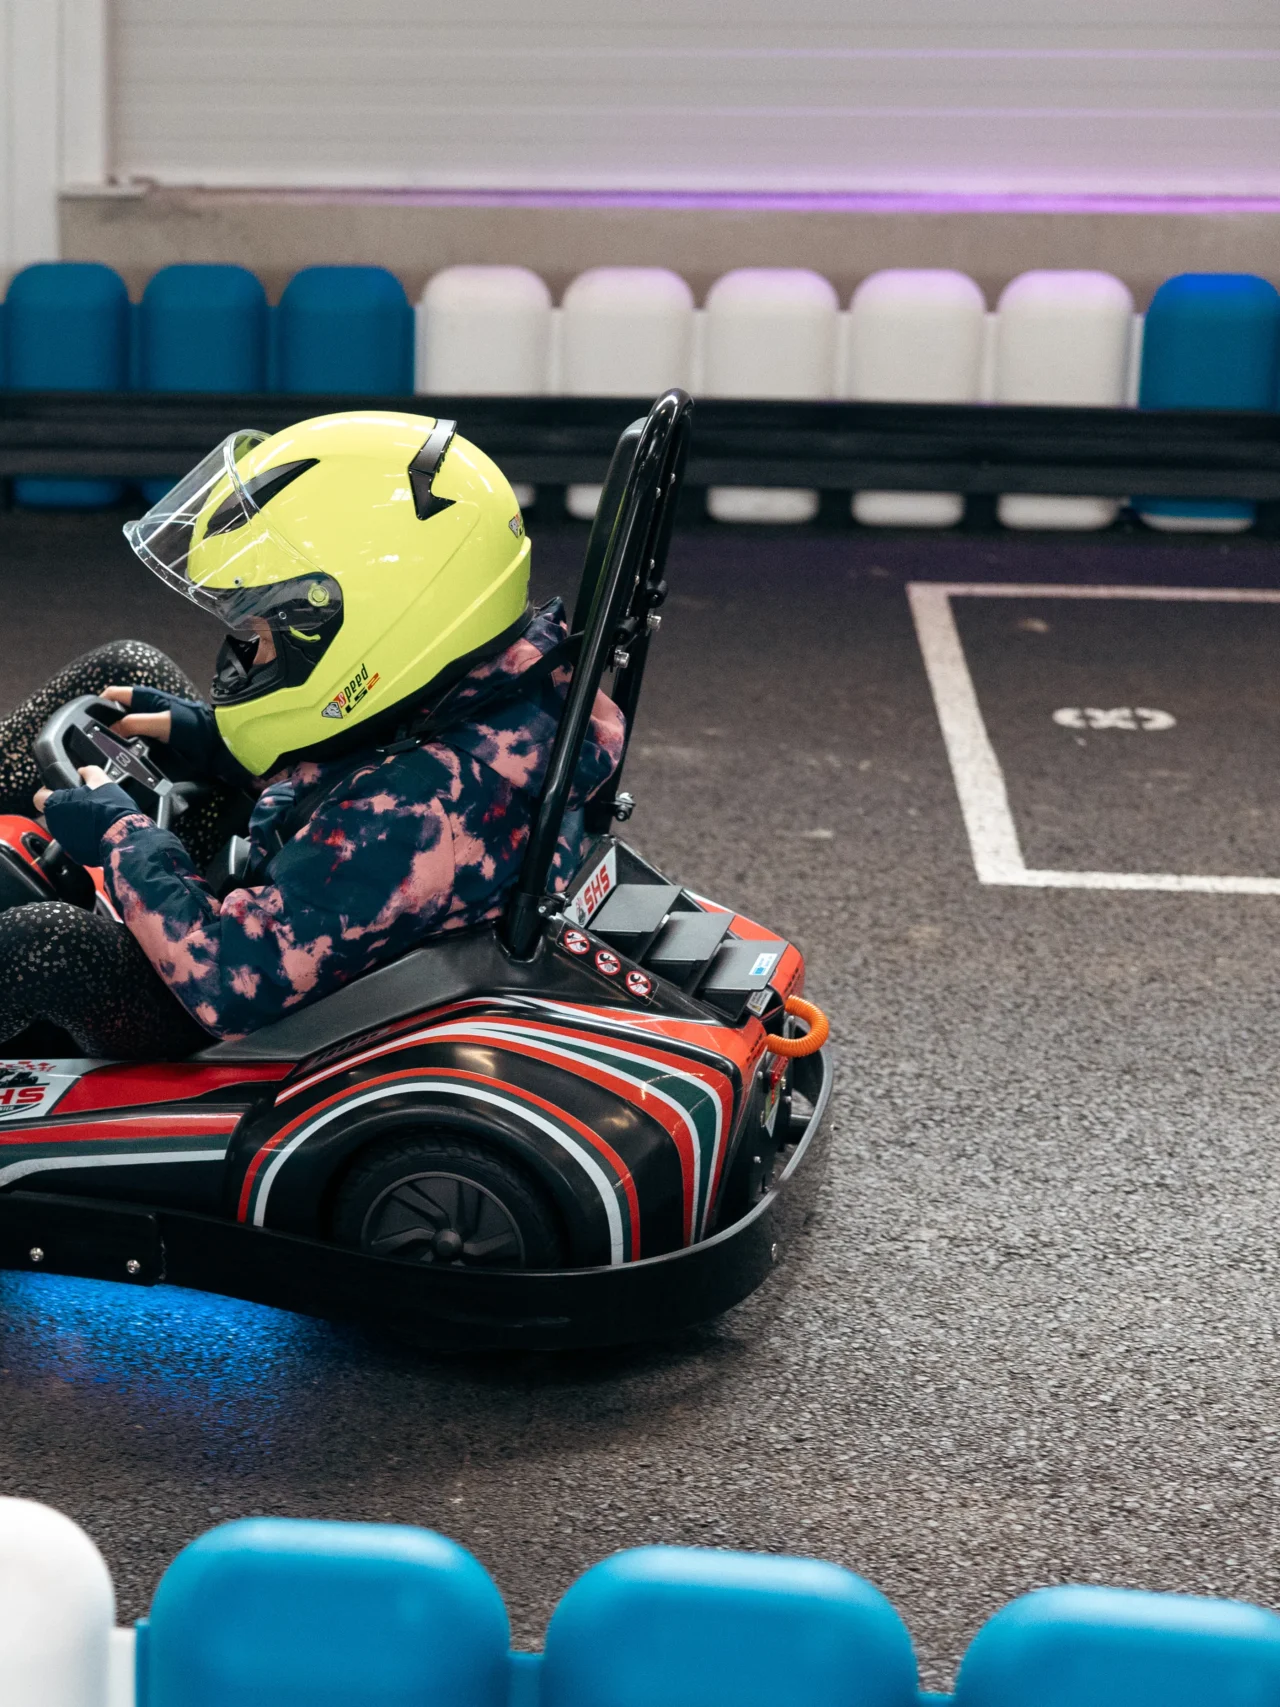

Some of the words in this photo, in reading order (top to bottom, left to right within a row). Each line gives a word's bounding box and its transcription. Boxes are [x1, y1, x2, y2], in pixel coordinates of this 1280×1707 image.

[345, 673, 380, 713] LS2
[1052, 707, 1176, 731] 8
[584, 864, 610, 915] SHS
